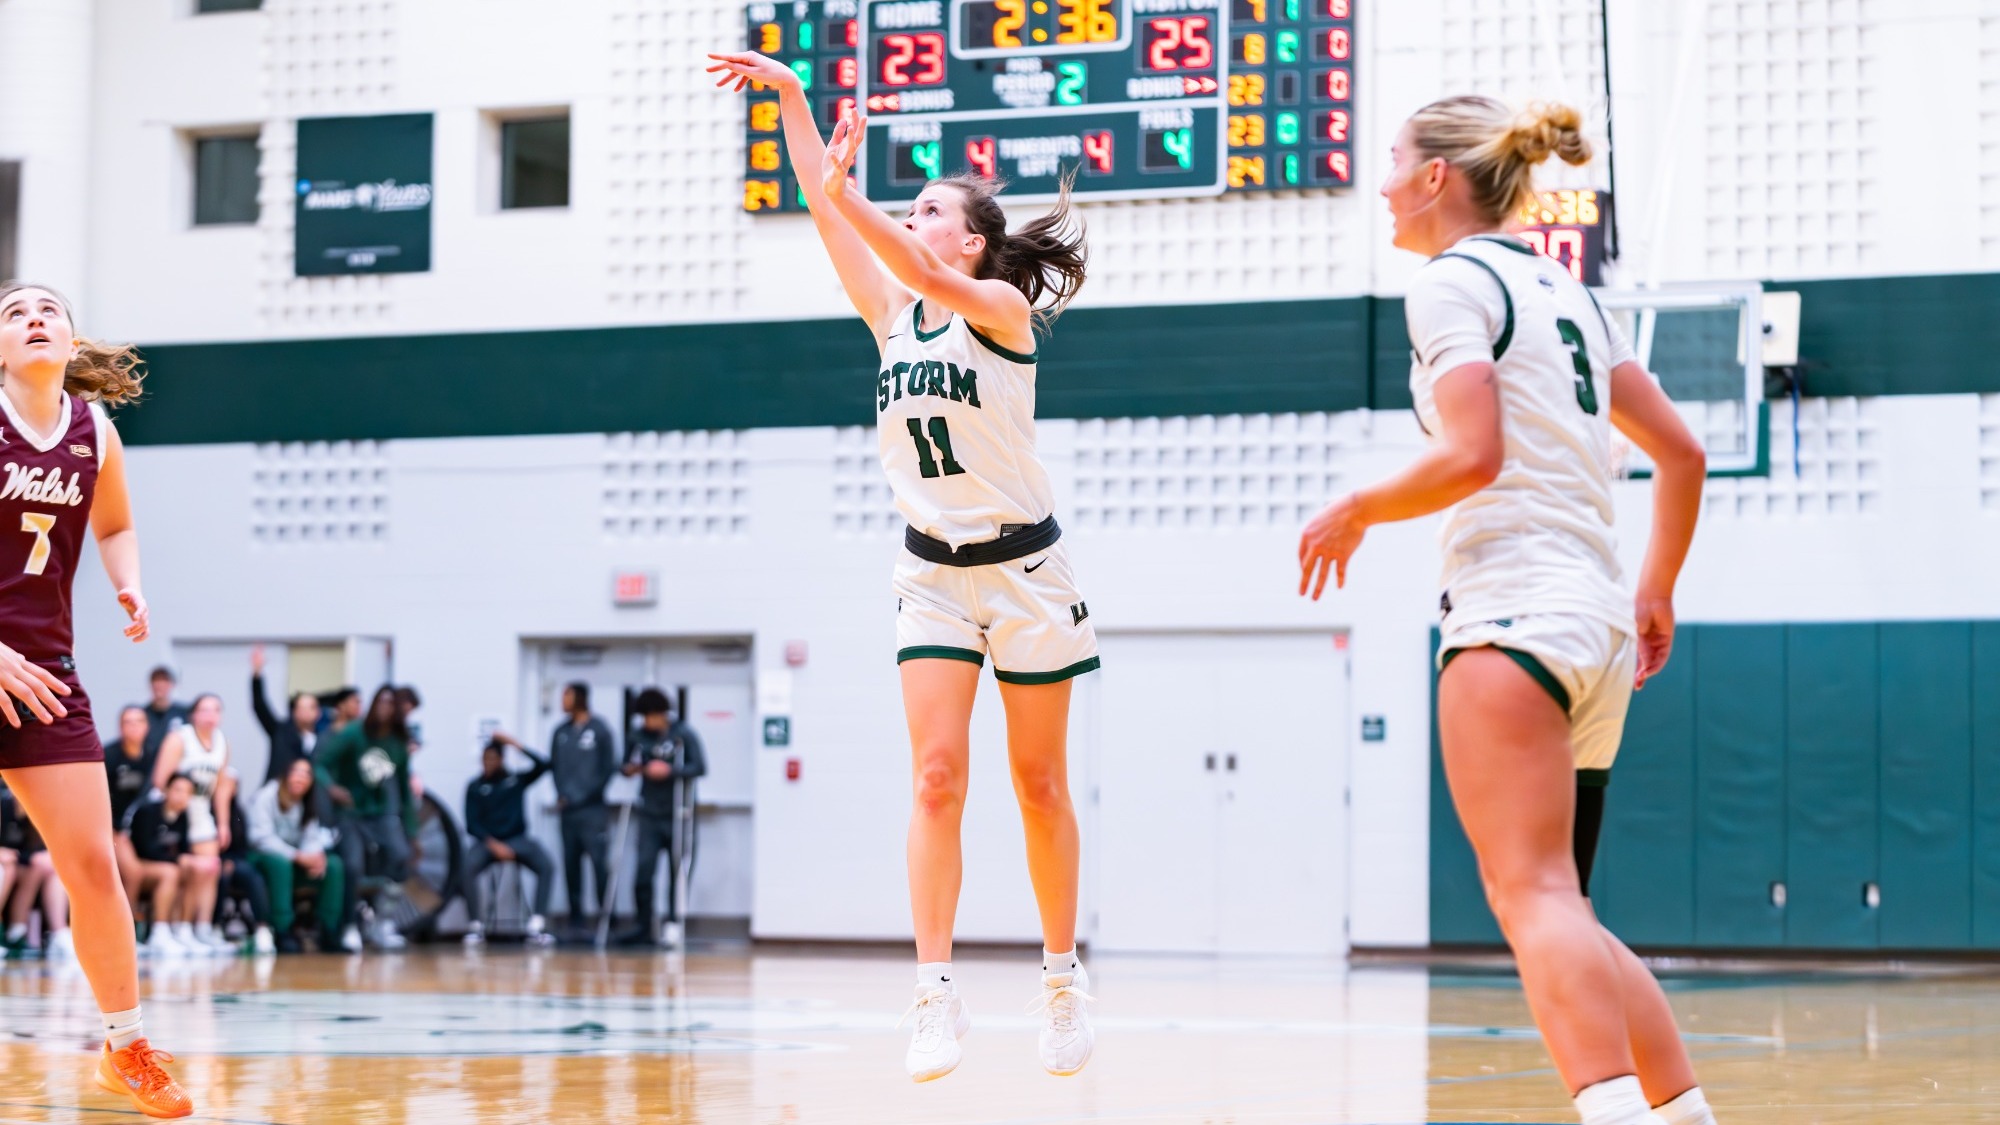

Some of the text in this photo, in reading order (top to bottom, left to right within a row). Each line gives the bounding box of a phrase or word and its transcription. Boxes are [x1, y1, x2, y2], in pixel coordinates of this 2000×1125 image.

[876, 1, 942, 28] HOME
[993, 0, 1116, 47] 2:36
[760, 22, 781, 54] 3
[1149, 16, 1212, 70] 25
[1327, 28, 1349, 60] 0
[883, 33, 945, 86] 23
[899, 88, 954, 111] BONUS
[1057, 61, 1085, 106] 2
[1126, 76, 1184, 99] BONUS
[1227, 74, 1265, 106] 22
[1327, 69, 1349, 101] 0
[888, 121, 942, 142] FOULS
[1139, 108, 1194, 130] FOULS
[1227, 114, 1265, 147] 23
[1328, 110, 1349, 142] 2
[912, 140, 940, 180] 4
[966, 137, 994, 178] 4
[999, 135, 1081, 159] TIMEOUTS
[1083, 132, 1112, 174] 4
[1163, 128, 1191, 169] 4
[1226, 155, 1265, 187] 24
[1285, 153, 1299, 184] 1
[1327, 151, 1349, 182] 9
[1557, 318, 1598, 416] 3
[877, 360, 981, 412] STORM
[907, 416, 967, 479] 11
[0, 461, 83, 507] Walsh
[20, 512, 57, 576] 7
